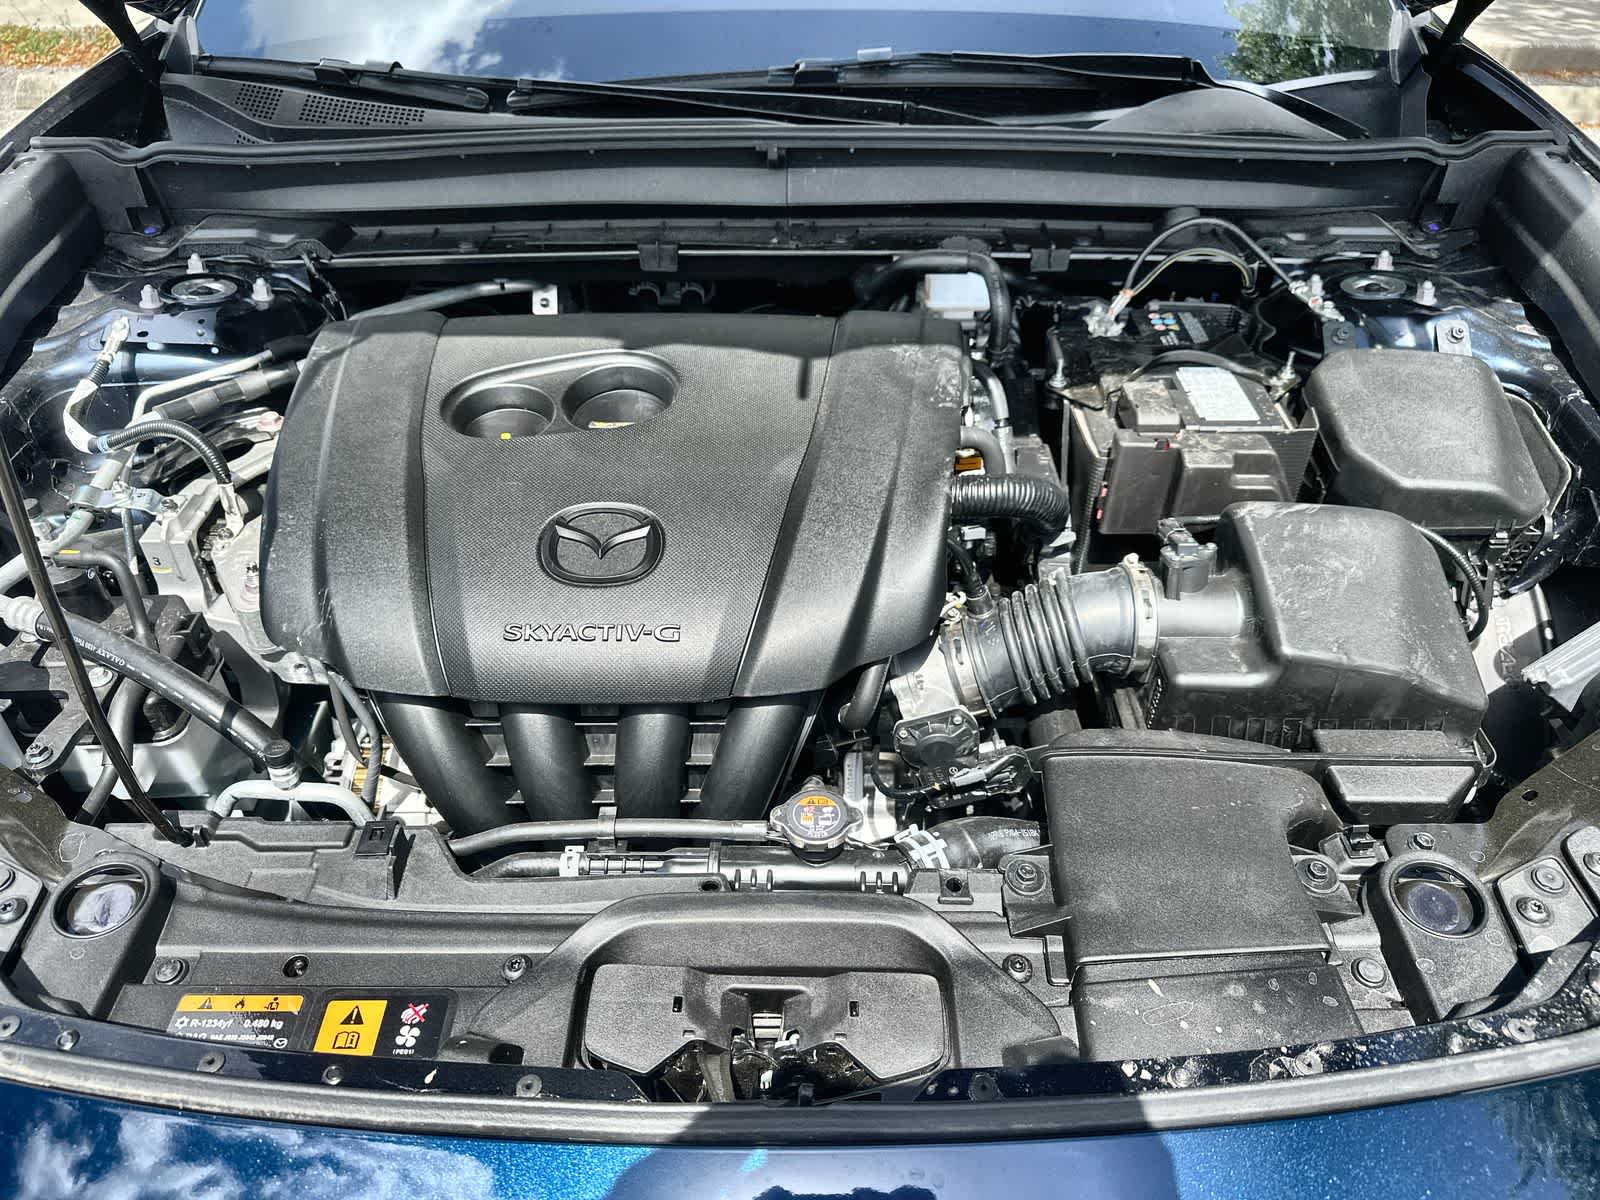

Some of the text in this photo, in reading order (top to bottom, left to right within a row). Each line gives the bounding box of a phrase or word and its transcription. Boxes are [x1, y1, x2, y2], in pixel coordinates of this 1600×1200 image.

[503, 623, 681, 642] SKYACTIV-G
[95, 647, 126, 666] GALAXY
[190, 1018, 284, 1030] R-1234yf 0.480 kg
